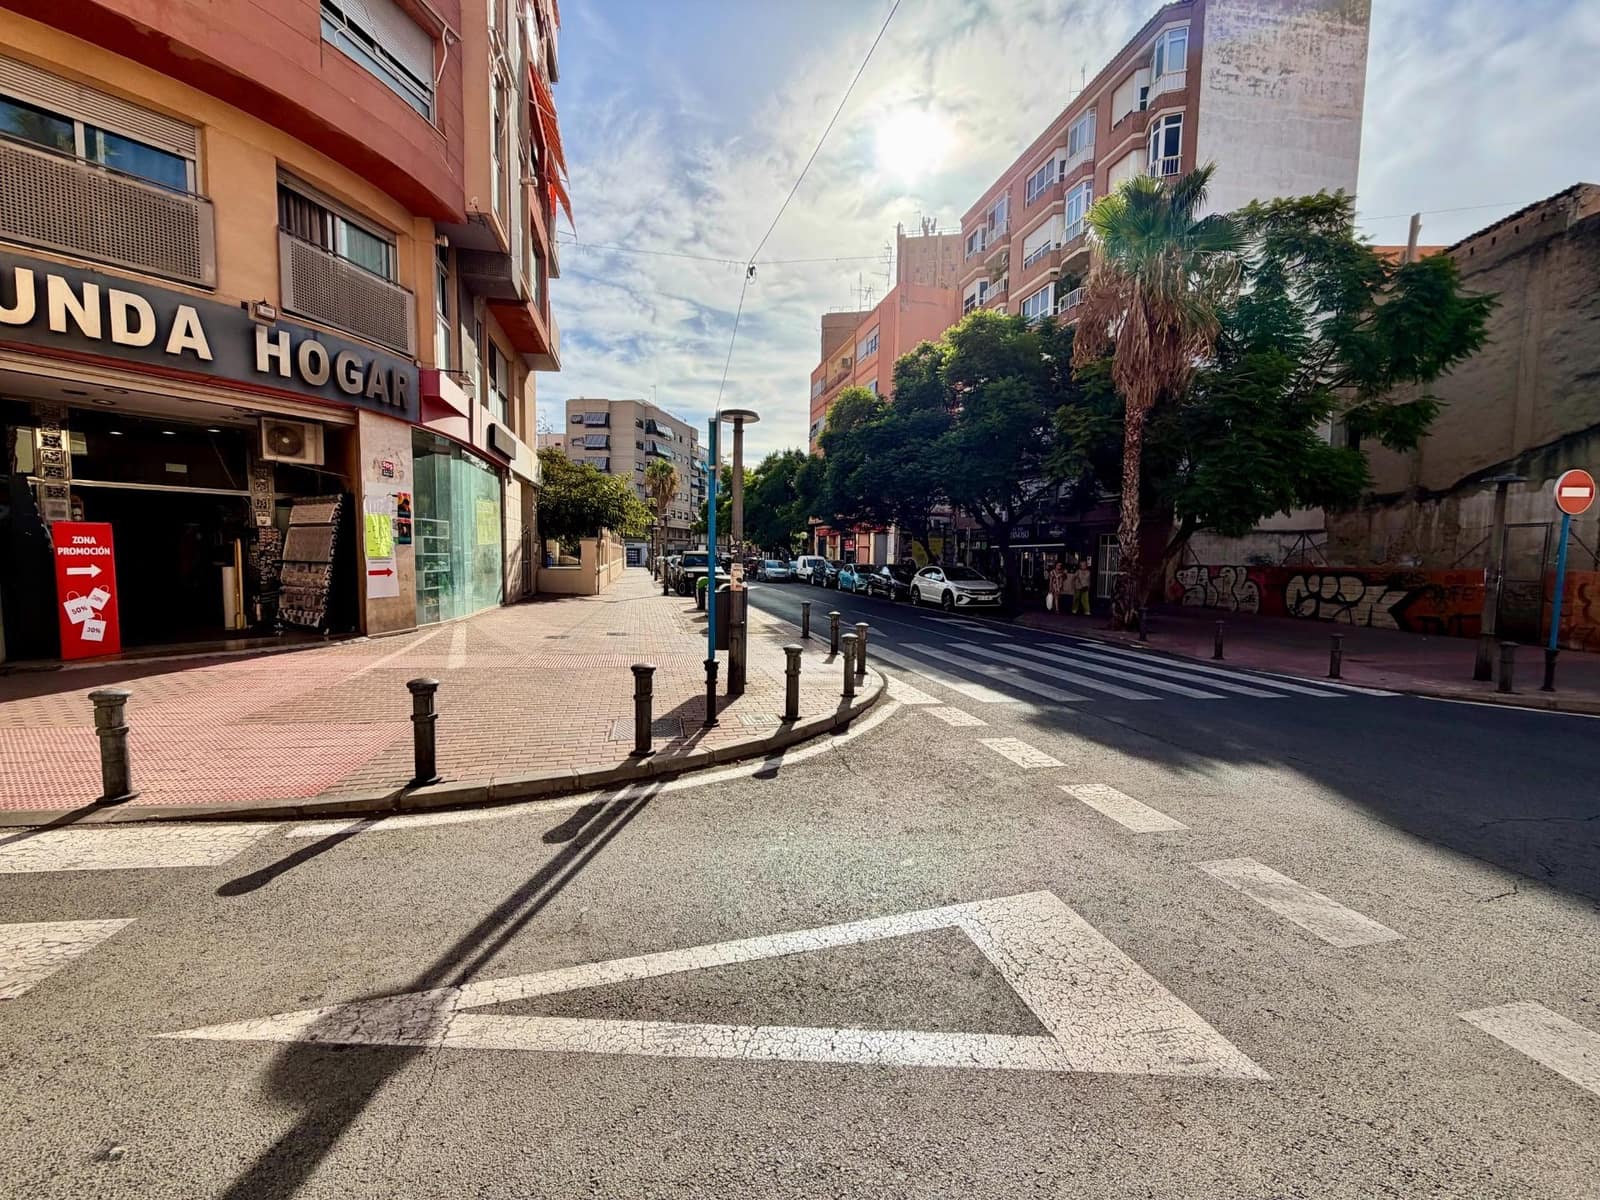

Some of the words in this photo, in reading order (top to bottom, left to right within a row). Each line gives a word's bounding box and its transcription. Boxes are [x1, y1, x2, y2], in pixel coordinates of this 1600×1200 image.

[255, 324, 410, 409] HOGAR
[72, 536, 97, 544] ZONA
[57, 546, 110, 556] PROMOCIÓN
